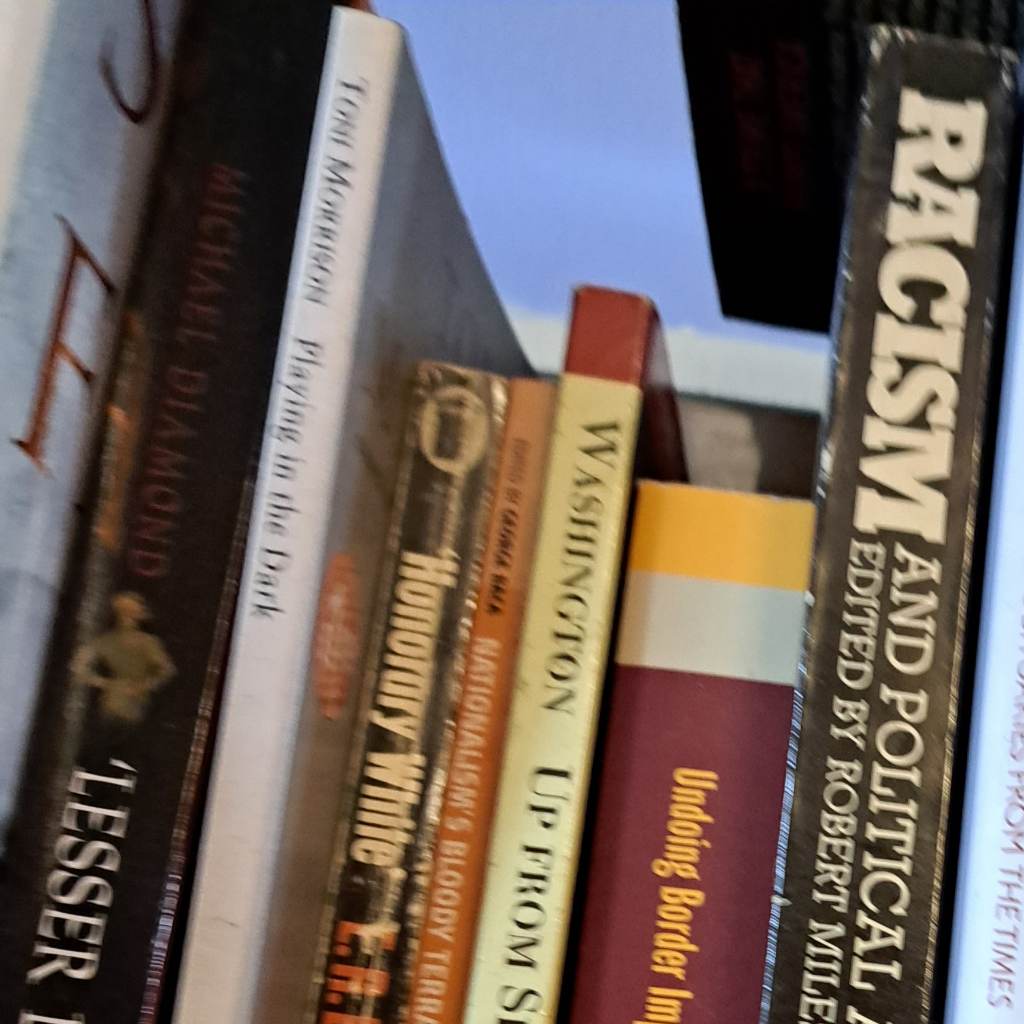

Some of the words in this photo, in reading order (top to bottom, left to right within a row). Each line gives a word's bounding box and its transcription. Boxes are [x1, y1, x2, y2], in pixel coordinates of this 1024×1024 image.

[853, 89, 989, 545] RACISM
[271, 336, 325, 447] Playing
[131, 366, 209, 579] DIAMOND
[257, 494, 302, 541] the
[270, 450, 292, 482] in
[250, 552, 295, 620] Dark
[541, 419, 622, 714] WASHINGTON
[836, 538, 886, 690] EDITED
[882, 544, 942, 673] AND
[445, 637, 501, 833] NATIONALISM'S
[828, 696, 870, 747] BY
[25, 757, 137, 985] 'LESSER
[653, 767, 718, 877] Undoing
[812, 755, 863, 914] ROBERT
[848, 685, 929, 993] POLITICAL
[428, 840, 468, 943] BLOODY
[650, 885, 706, 996] Border
